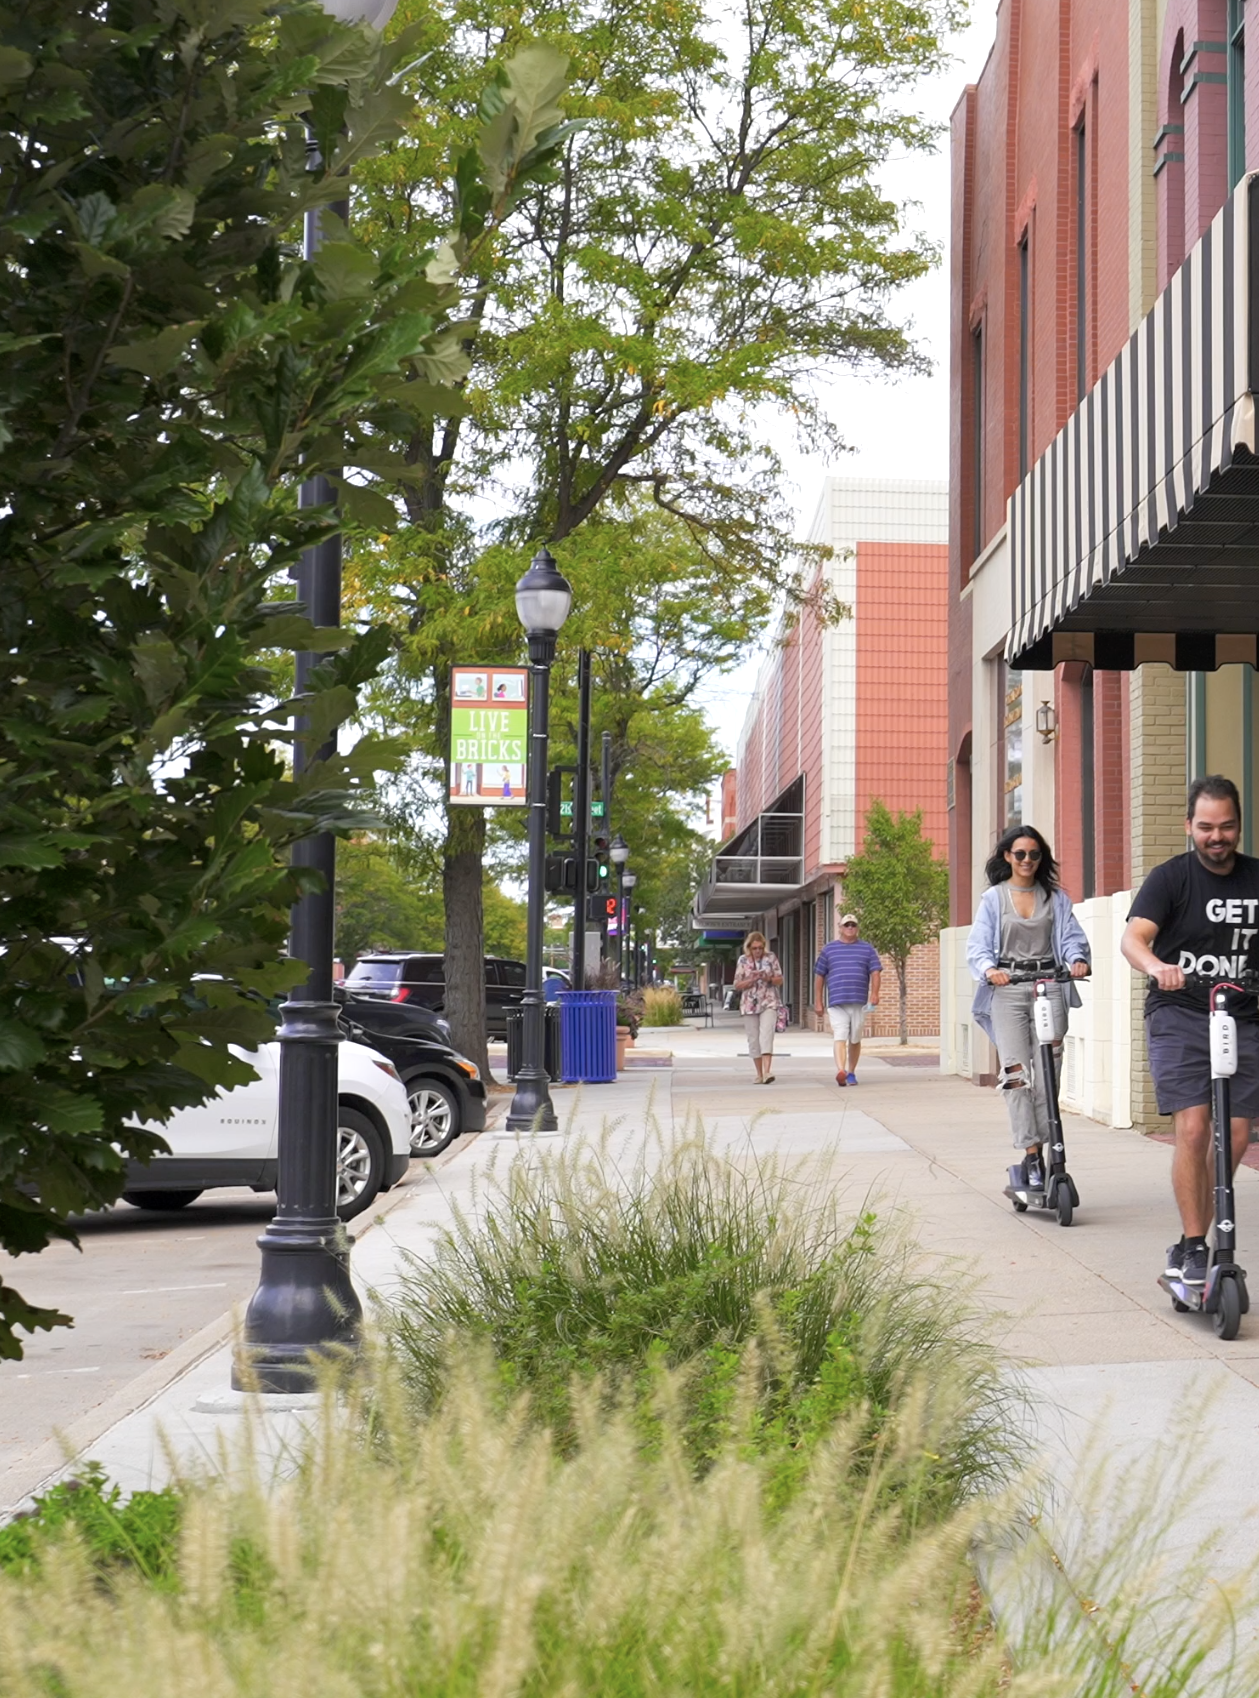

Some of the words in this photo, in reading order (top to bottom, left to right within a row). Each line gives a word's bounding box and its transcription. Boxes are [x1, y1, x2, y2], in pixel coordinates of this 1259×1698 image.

[469, 711, 510, 731] LIVE
[456, 739, 521, 760] BRICKS
[1205, 898, 1259, 924] GET
[1231, 928, 1258, 950] IT
[1222, 1024, 1230, 1054] BIRD
